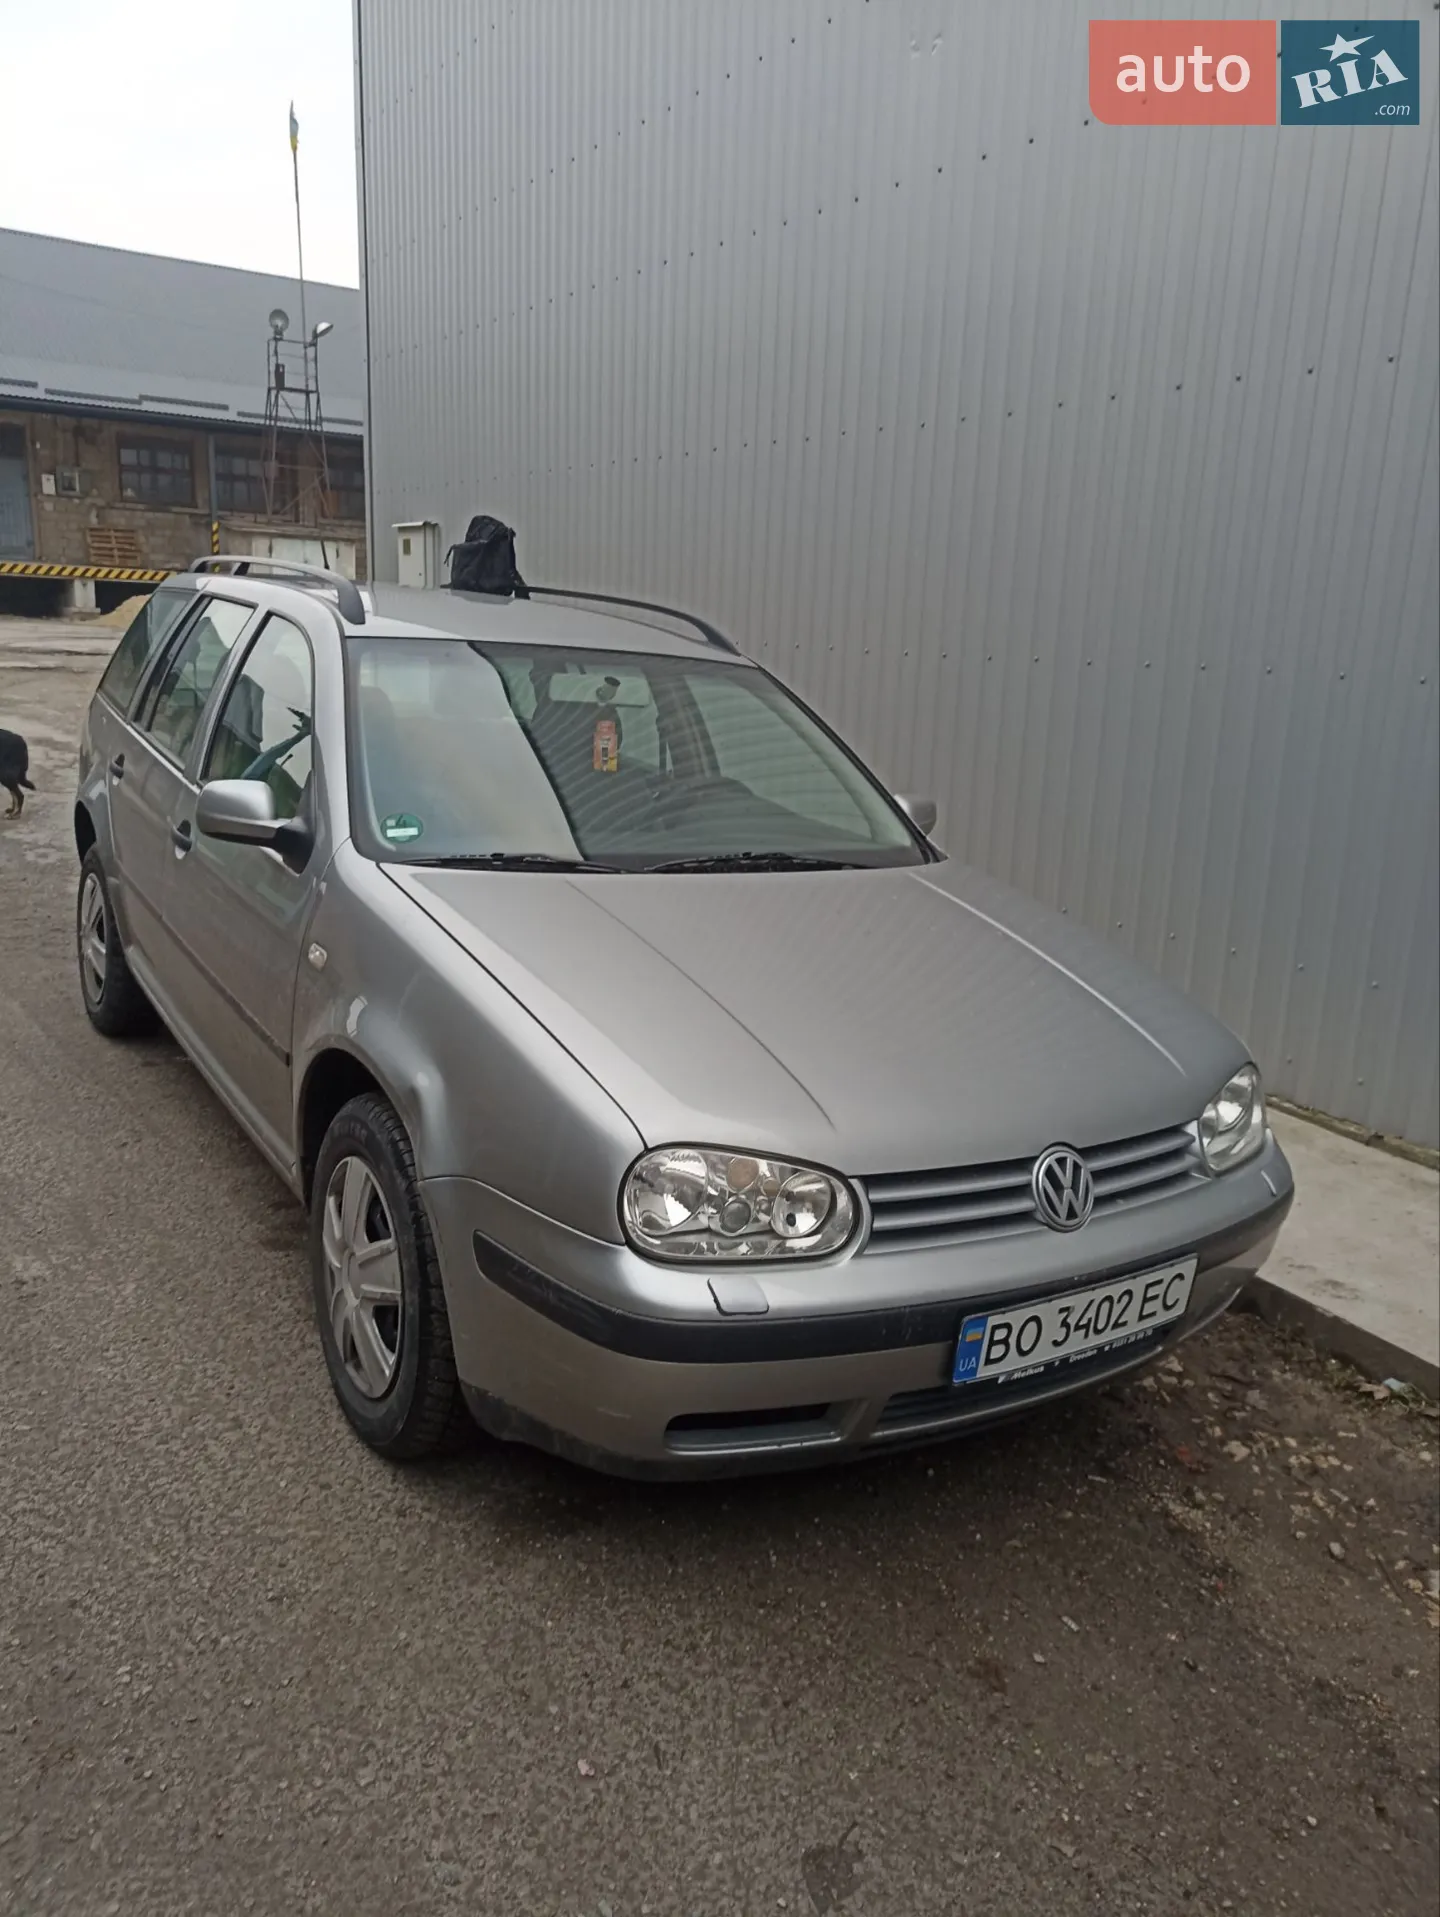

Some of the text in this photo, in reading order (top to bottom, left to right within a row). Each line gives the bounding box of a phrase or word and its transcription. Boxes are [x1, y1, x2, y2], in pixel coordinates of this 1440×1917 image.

[983, 1314, 1043, 1367] BO
[1051, 1288, 1133, 1348] 3402
[1137, 1272, 1186, 1321] EC
[959, 1356, 977, 1371] UA
